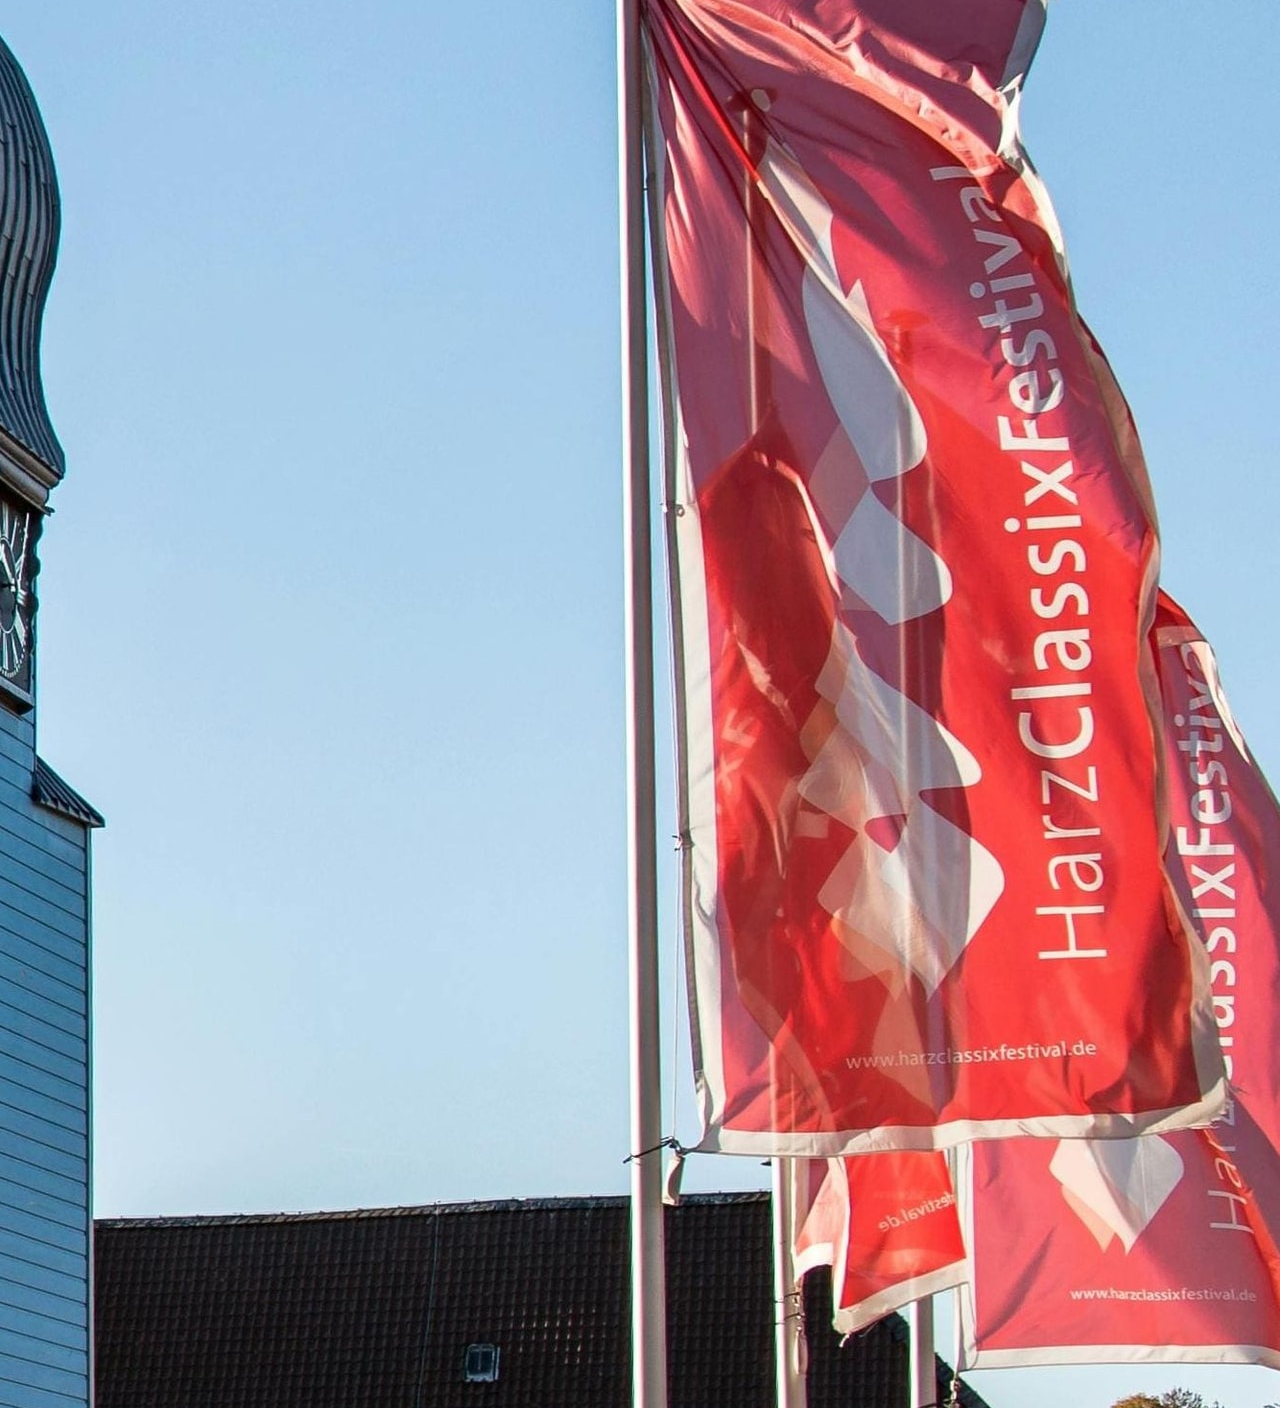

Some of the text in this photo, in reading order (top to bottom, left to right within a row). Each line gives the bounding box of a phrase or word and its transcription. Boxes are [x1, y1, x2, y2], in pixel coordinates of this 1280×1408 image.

[929, 166, 1109, 963] HarzClassixFestival
[846, 1040, 1097, 1069] www.harzclassixfestival.de
[1070, 1287, 1257, 1302] www.harzclassixfestival.de
